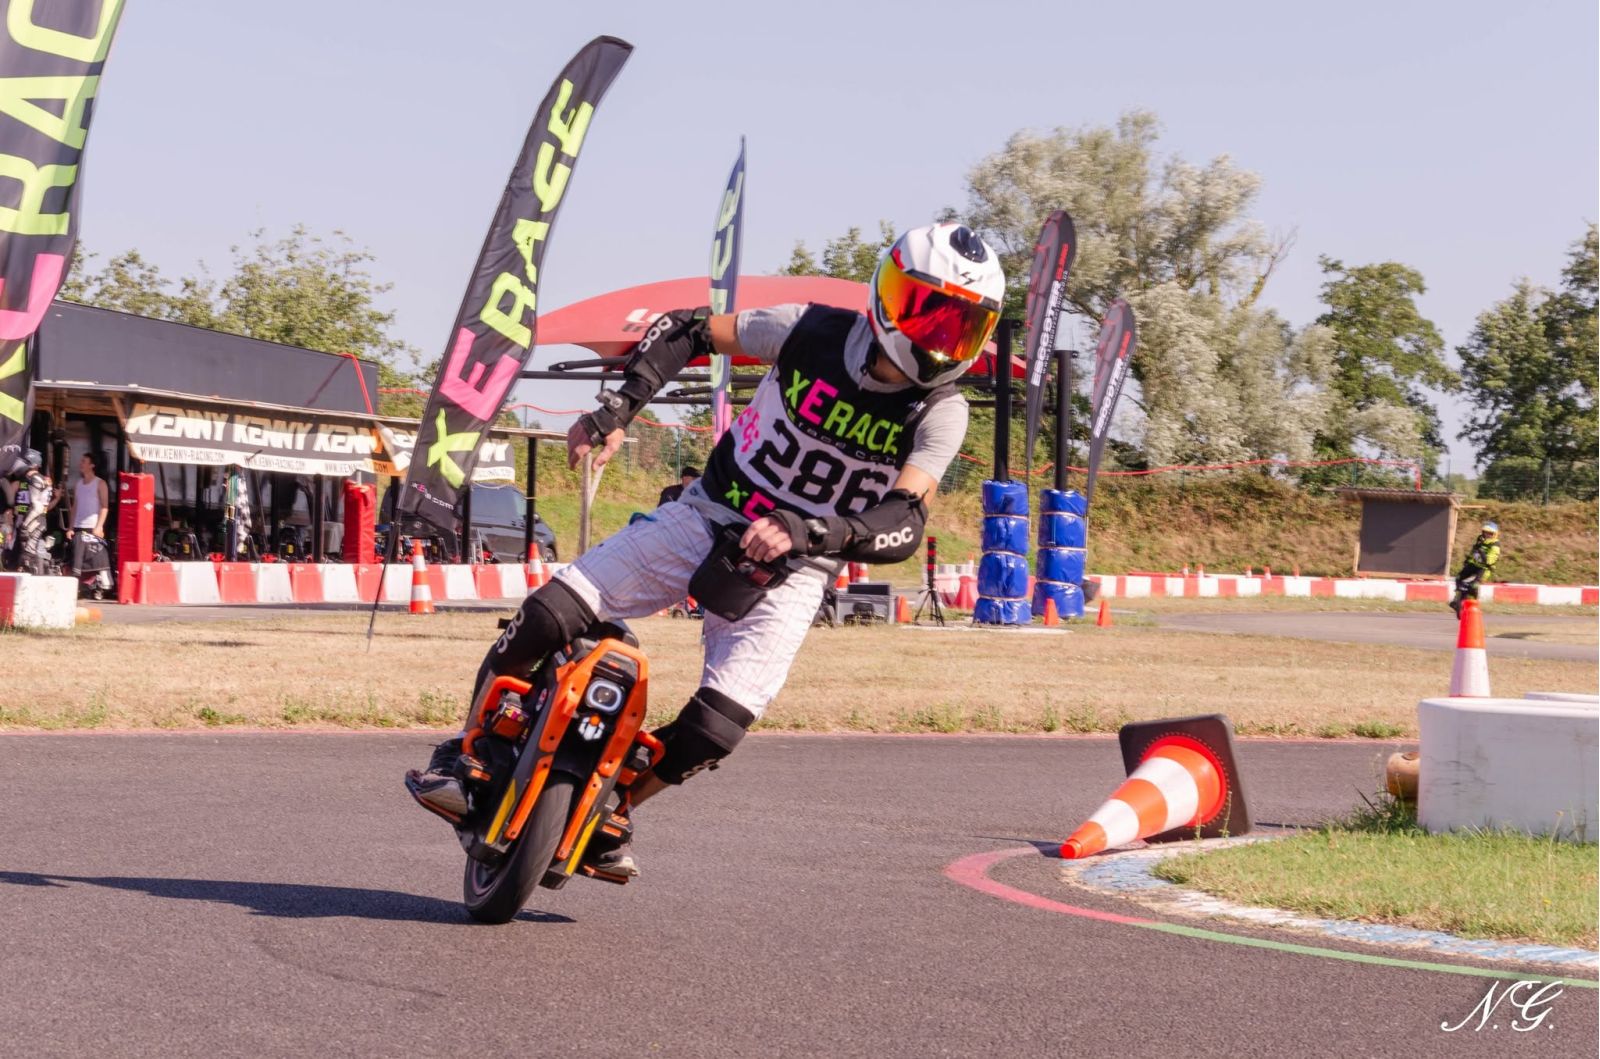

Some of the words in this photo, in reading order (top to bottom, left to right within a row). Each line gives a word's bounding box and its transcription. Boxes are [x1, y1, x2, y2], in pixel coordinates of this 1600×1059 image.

[125, 402, 229, 442] KENNY
[233, 413, 314, 451] KENNY
[748, 418, 890, 517] 286
